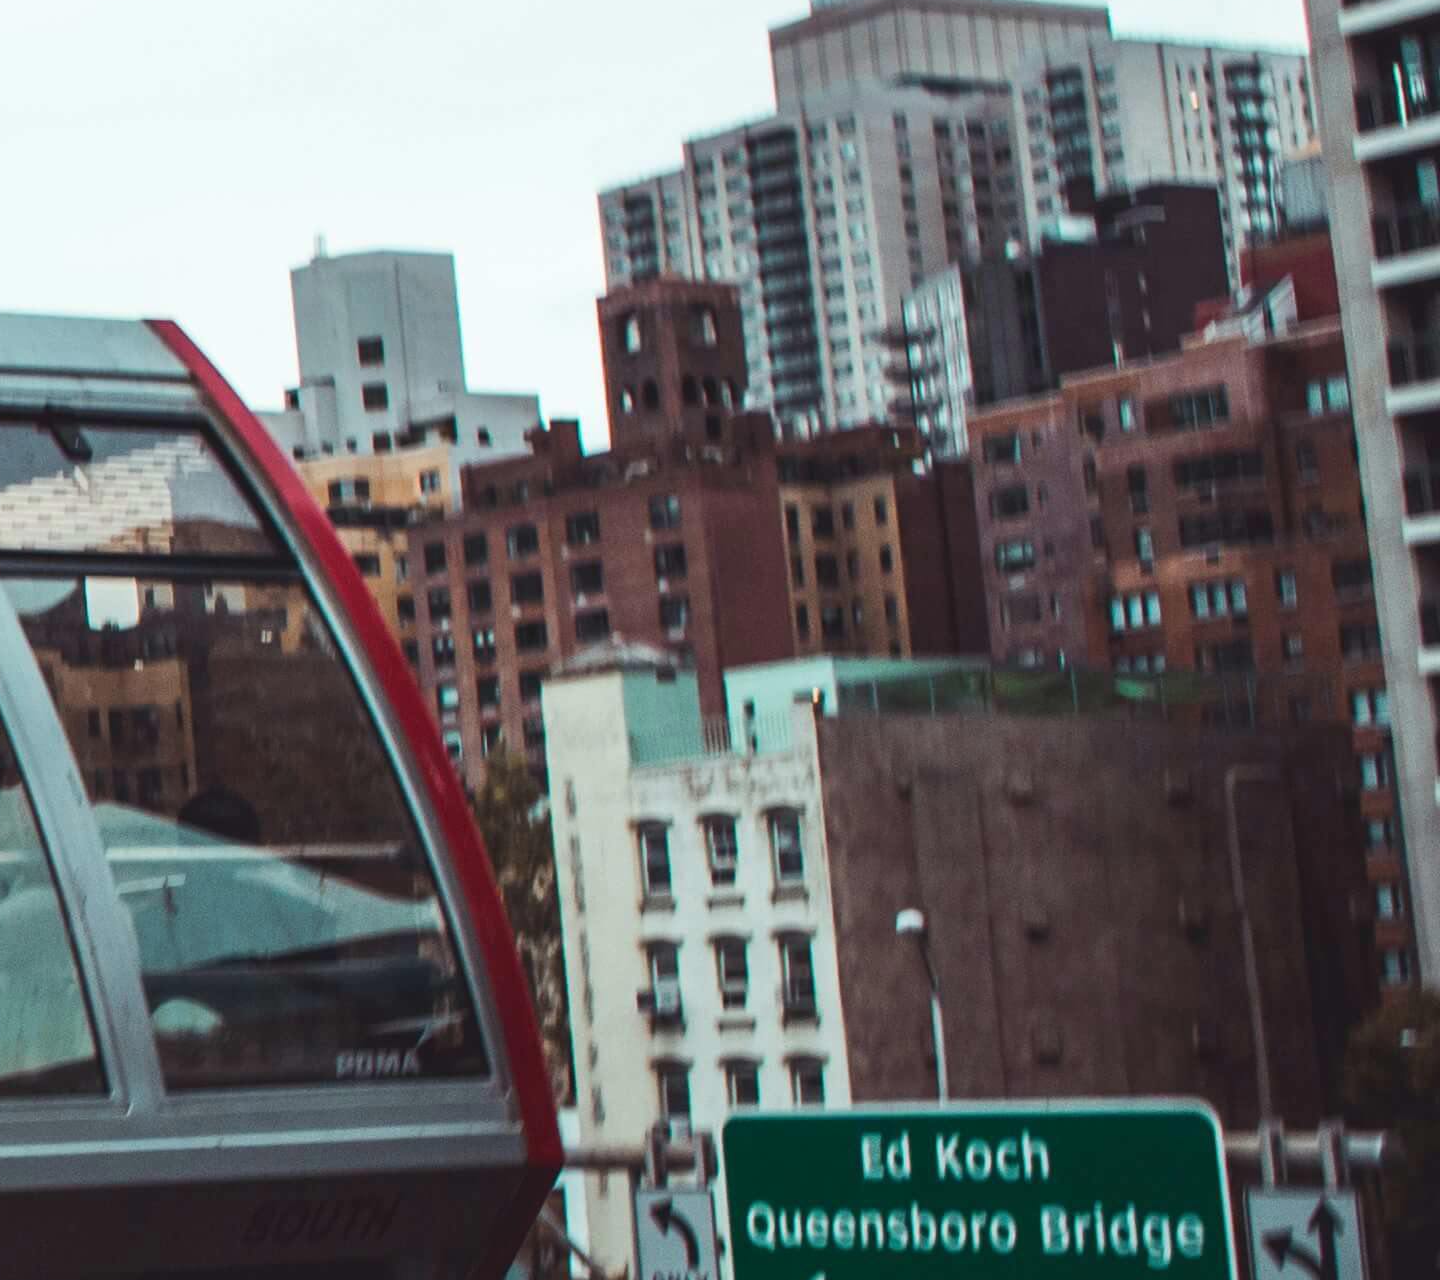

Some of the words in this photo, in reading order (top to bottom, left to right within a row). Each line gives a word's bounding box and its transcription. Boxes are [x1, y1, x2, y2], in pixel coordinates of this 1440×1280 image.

[336, 1050, 420, 1078] POMA
[861, 1131, 912, 1180] Ed
[935, 1130, 1050, 1181] Koch
[747, 1200, 1017, 1253] Queensboro
[1040, 1202, 1205, 1269] Bridge
